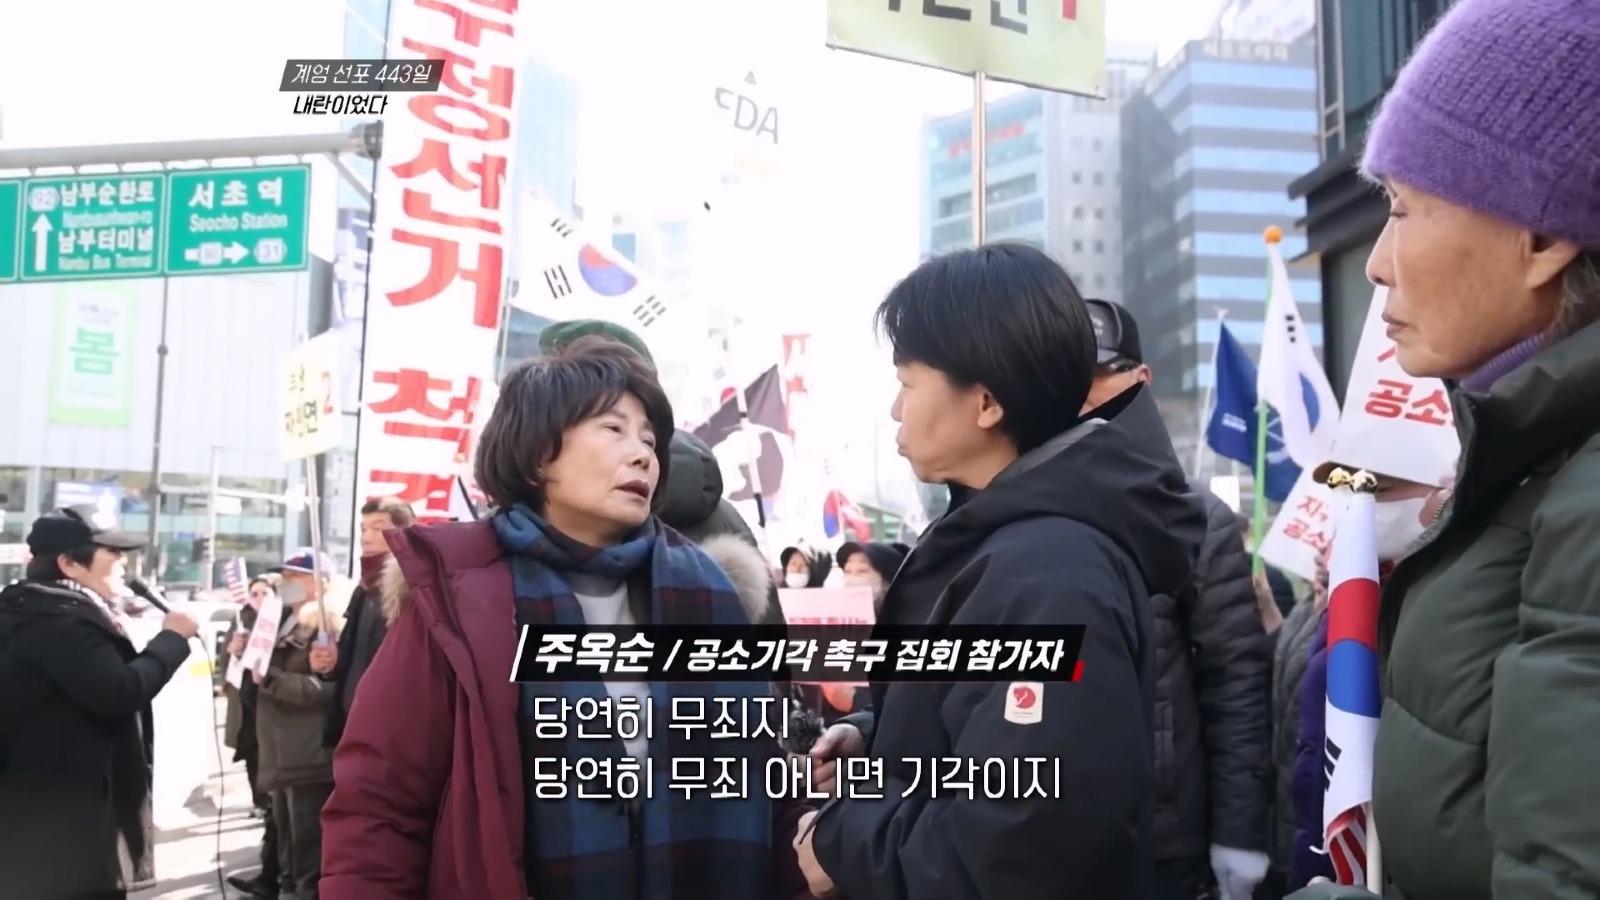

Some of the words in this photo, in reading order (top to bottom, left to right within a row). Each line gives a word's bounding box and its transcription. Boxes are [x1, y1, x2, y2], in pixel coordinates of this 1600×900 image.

[58, 226, 154, 254] 남부터미널
[189, 212, 238, 232] Seocho
[241, 211, 288, 230] Station
[67, 326, 120, 376] 봄
[1364, 379, 1455, 427] 공소
